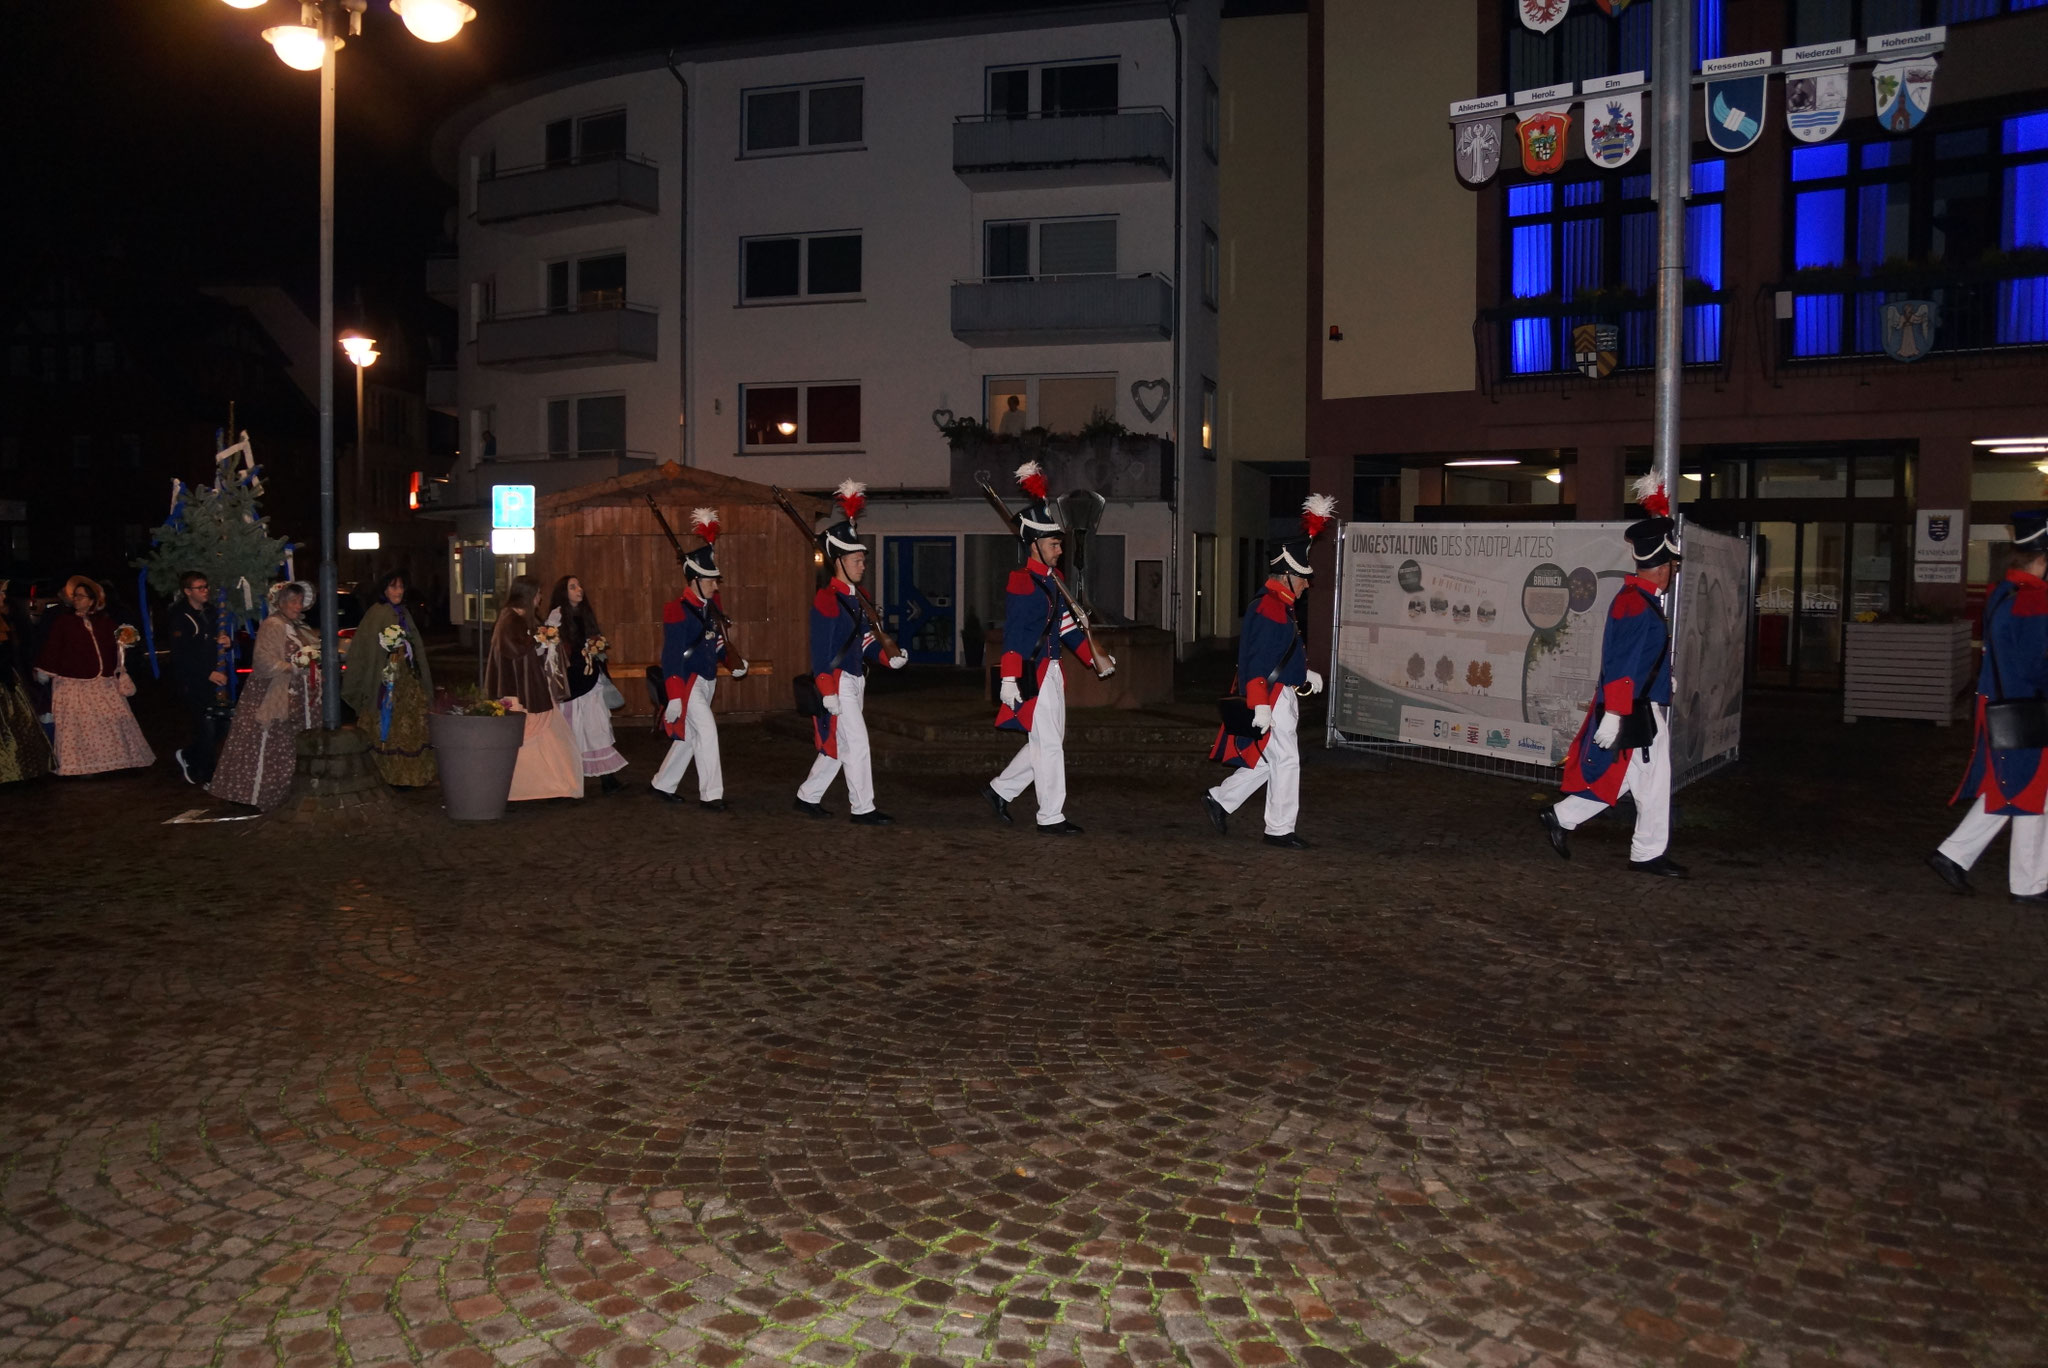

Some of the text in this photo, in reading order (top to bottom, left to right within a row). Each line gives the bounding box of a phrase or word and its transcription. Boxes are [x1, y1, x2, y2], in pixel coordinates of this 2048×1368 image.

[1881, 32, 1931, 48] Hohenzell
[1795, 46, 1842, 60] Niederzell
[1707, 57, 1765, 71] Kressenbach
[1605, 80, 1621, 88] Elm
[1531, 89, 1555, 100] Herolz
[1458, 100, 1499, 113] Ahlersbach
[503, 491, 523, 522] P
[1352, 534, 1554, 558] UMGESTALTUNG DES STADTPLATZES
[1533, 575, 1562, 587] BRUNNEN
